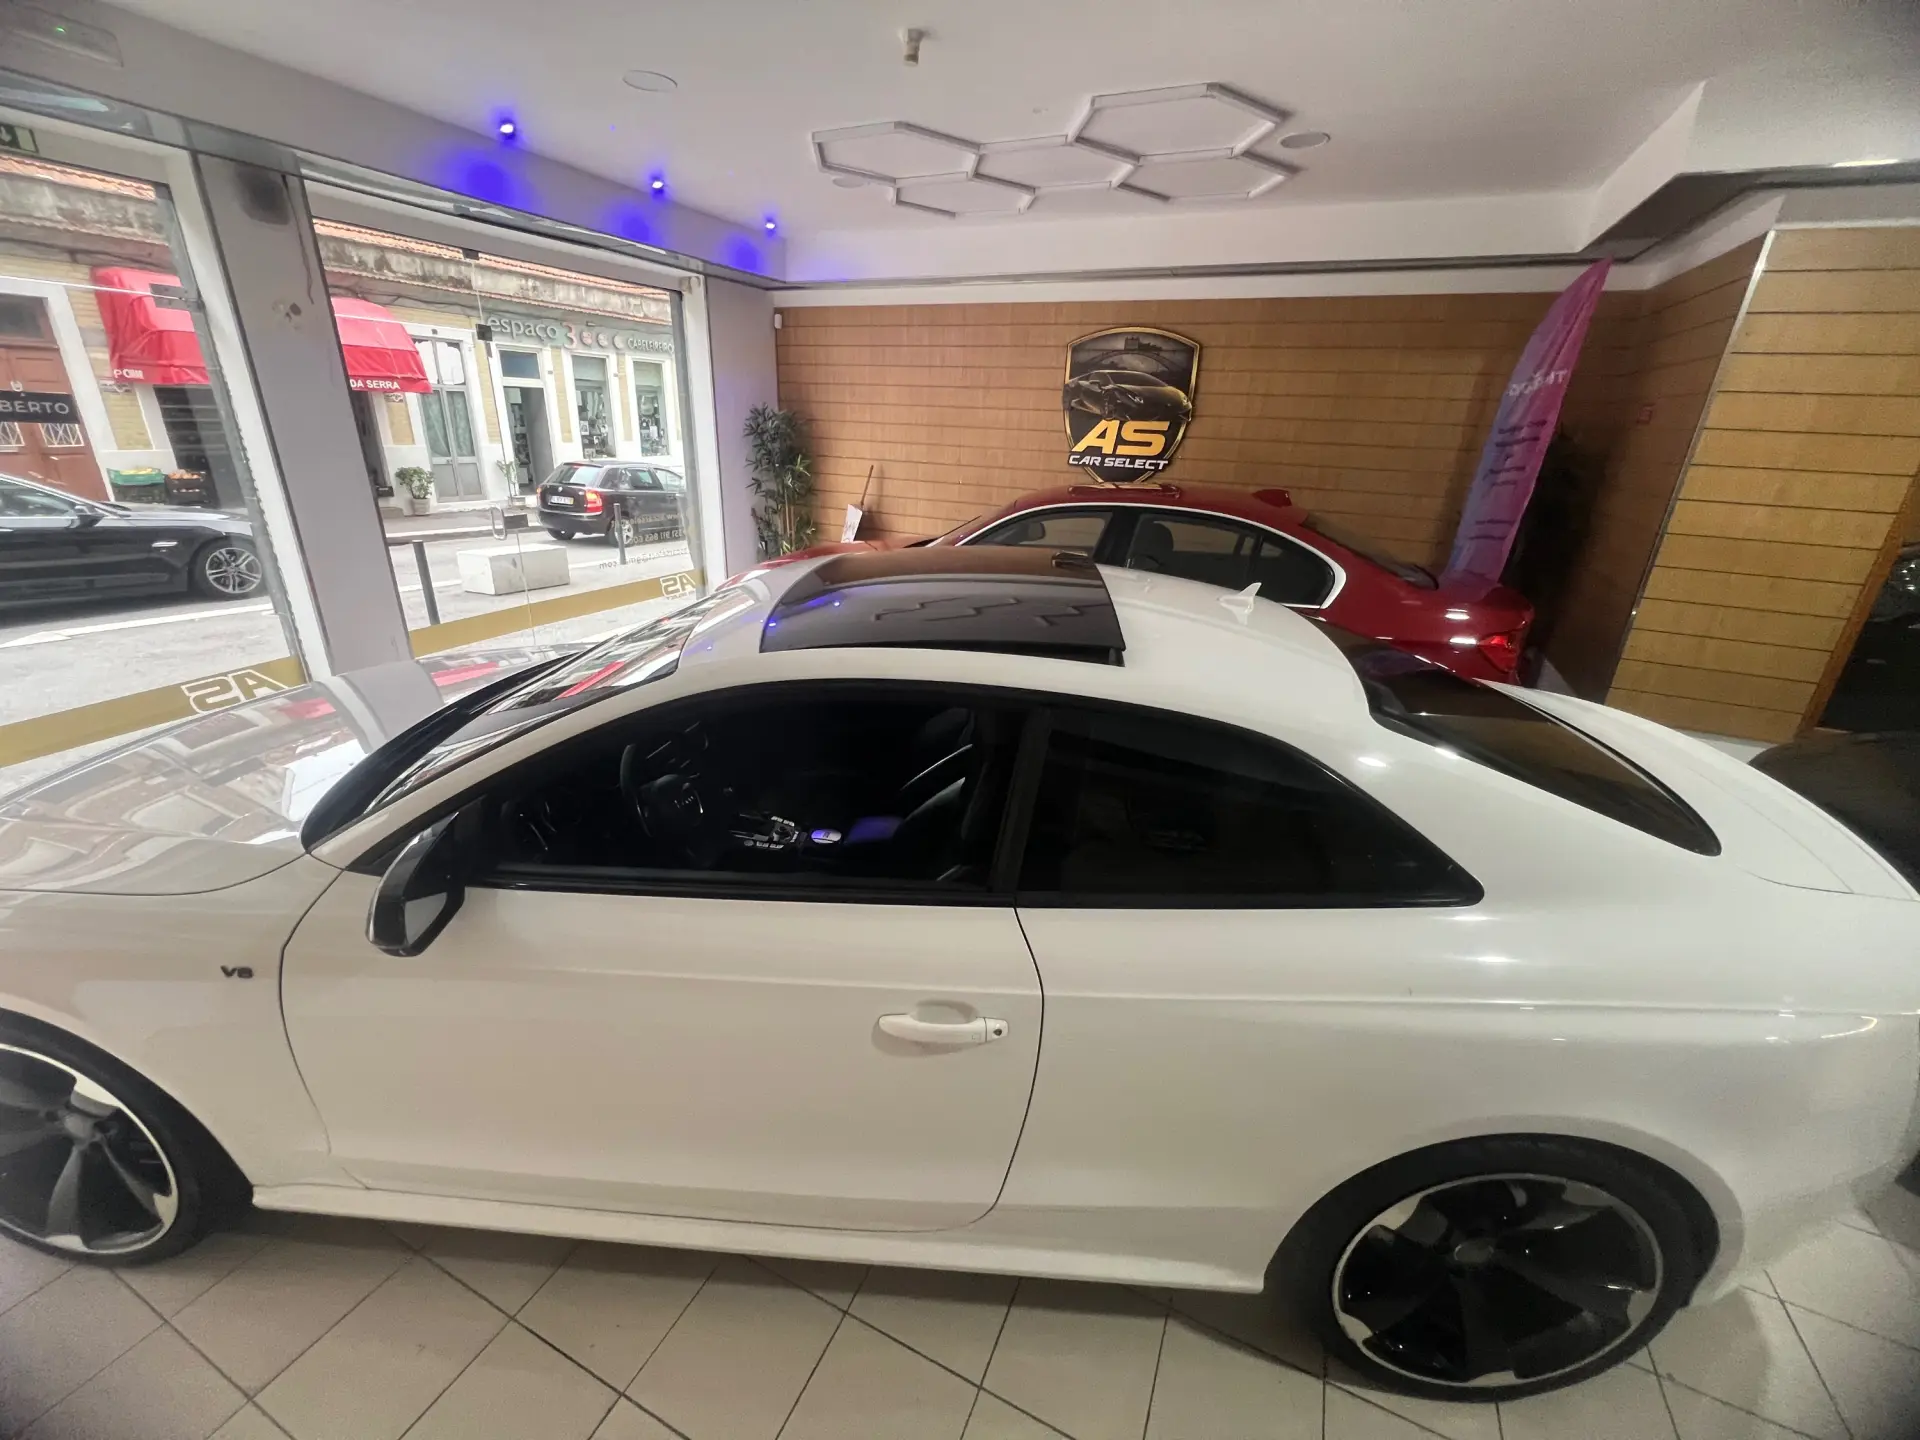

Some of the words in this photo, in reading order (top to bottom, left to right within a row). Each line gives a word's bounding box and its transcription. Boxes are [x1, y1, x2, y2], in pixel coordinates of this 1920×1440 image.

[487, 315, 557, 341] espaço
[562, 322, 578, 349] 3
[366, 380, 401, 389] SERRA
[1071, 419, 1170, 456] AS
[1069, 455, 1101, 466] CAR
[1104, 458, 1168, 470] SELECT
